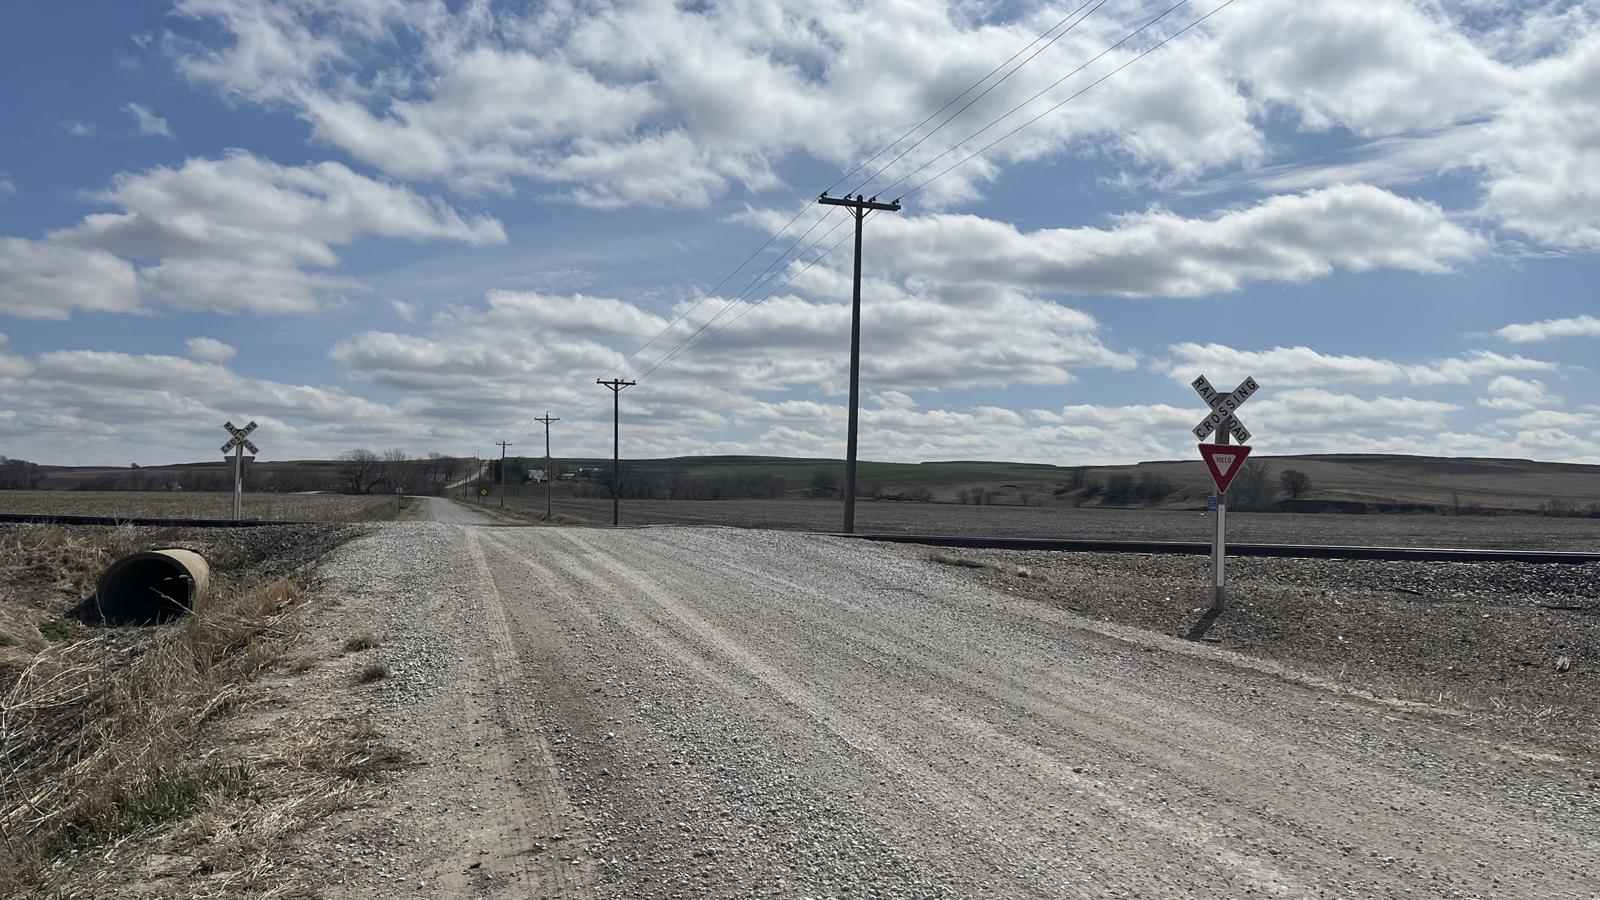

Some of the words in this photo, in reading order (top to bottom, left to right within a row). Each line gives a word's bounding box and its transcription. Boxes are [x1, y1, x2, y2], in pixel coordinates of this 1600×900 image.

[1194, 378, 1218, 408] RAIL
[1196, 380, 1256, 438] CROSSING
[1215, 456, 1232, 464] YIELD
